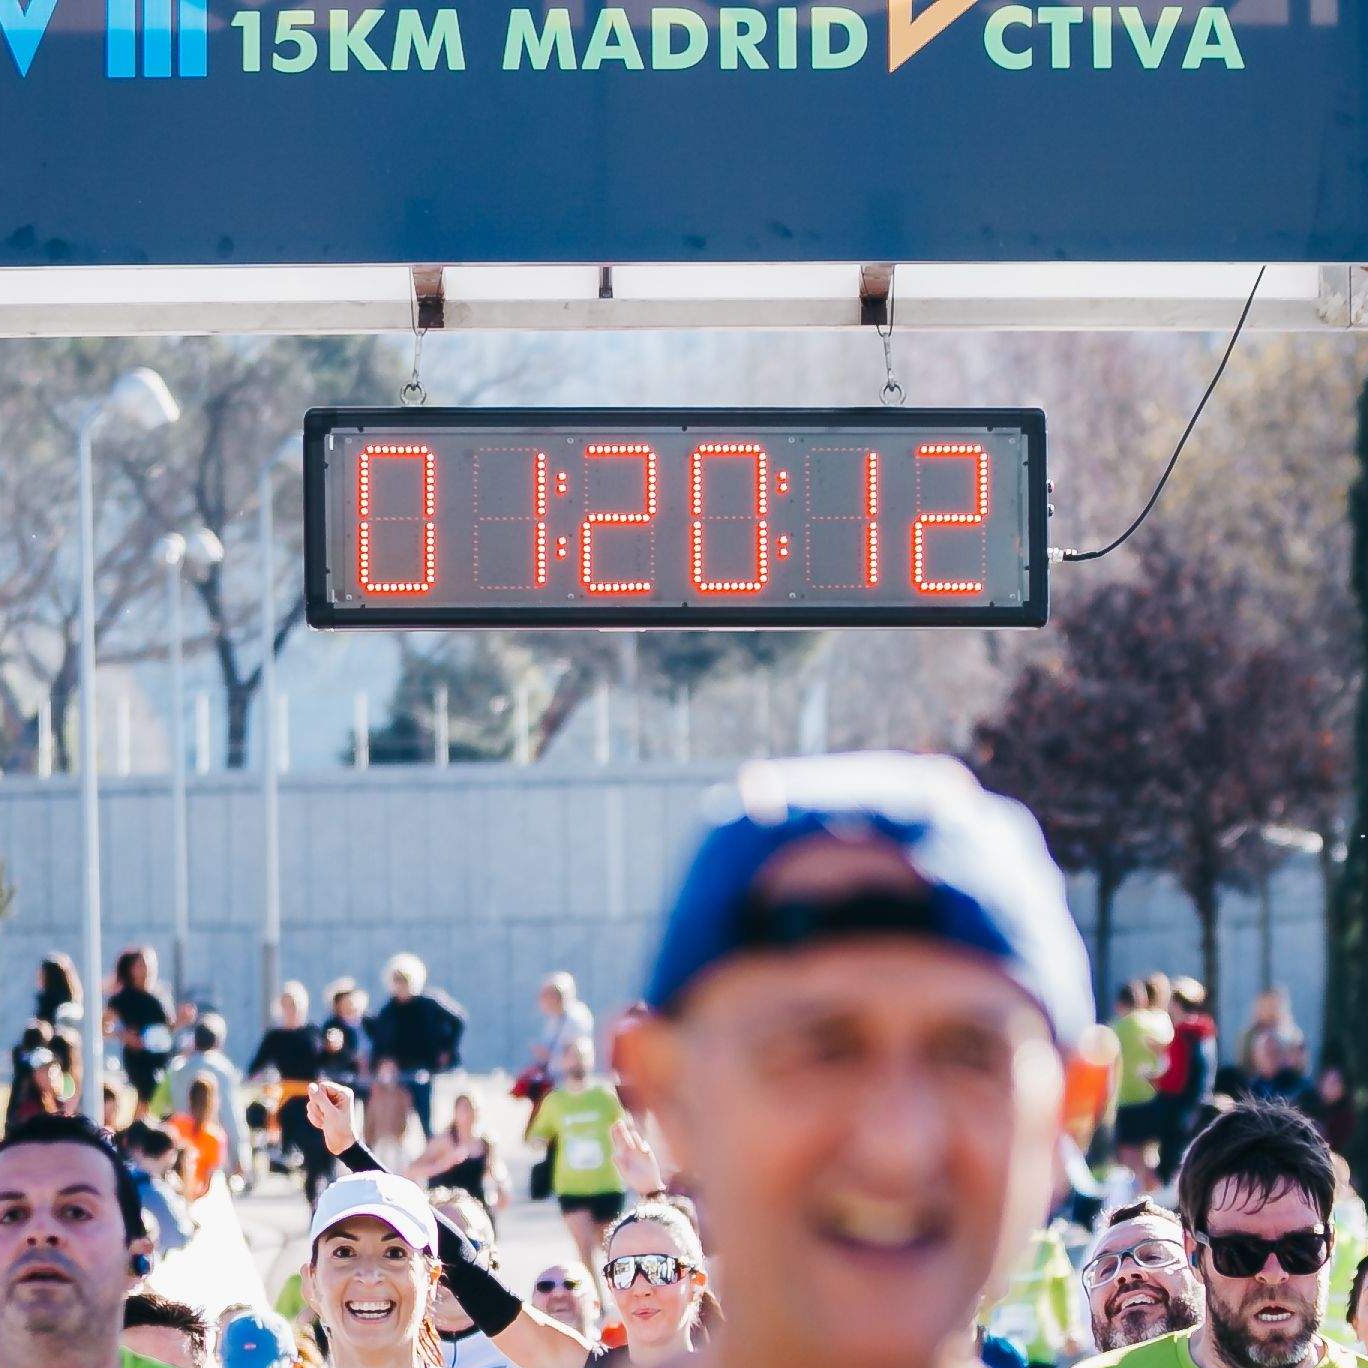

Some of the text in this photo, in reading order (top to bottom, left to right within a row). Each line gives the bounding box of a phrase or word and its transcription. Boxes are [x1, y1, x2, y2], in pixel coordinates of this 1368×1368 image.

[231, 8, 466, 73] 15KM
[502, 5, 869, 70] MADRID
[359, 442, 992, 595] 01:20:12
